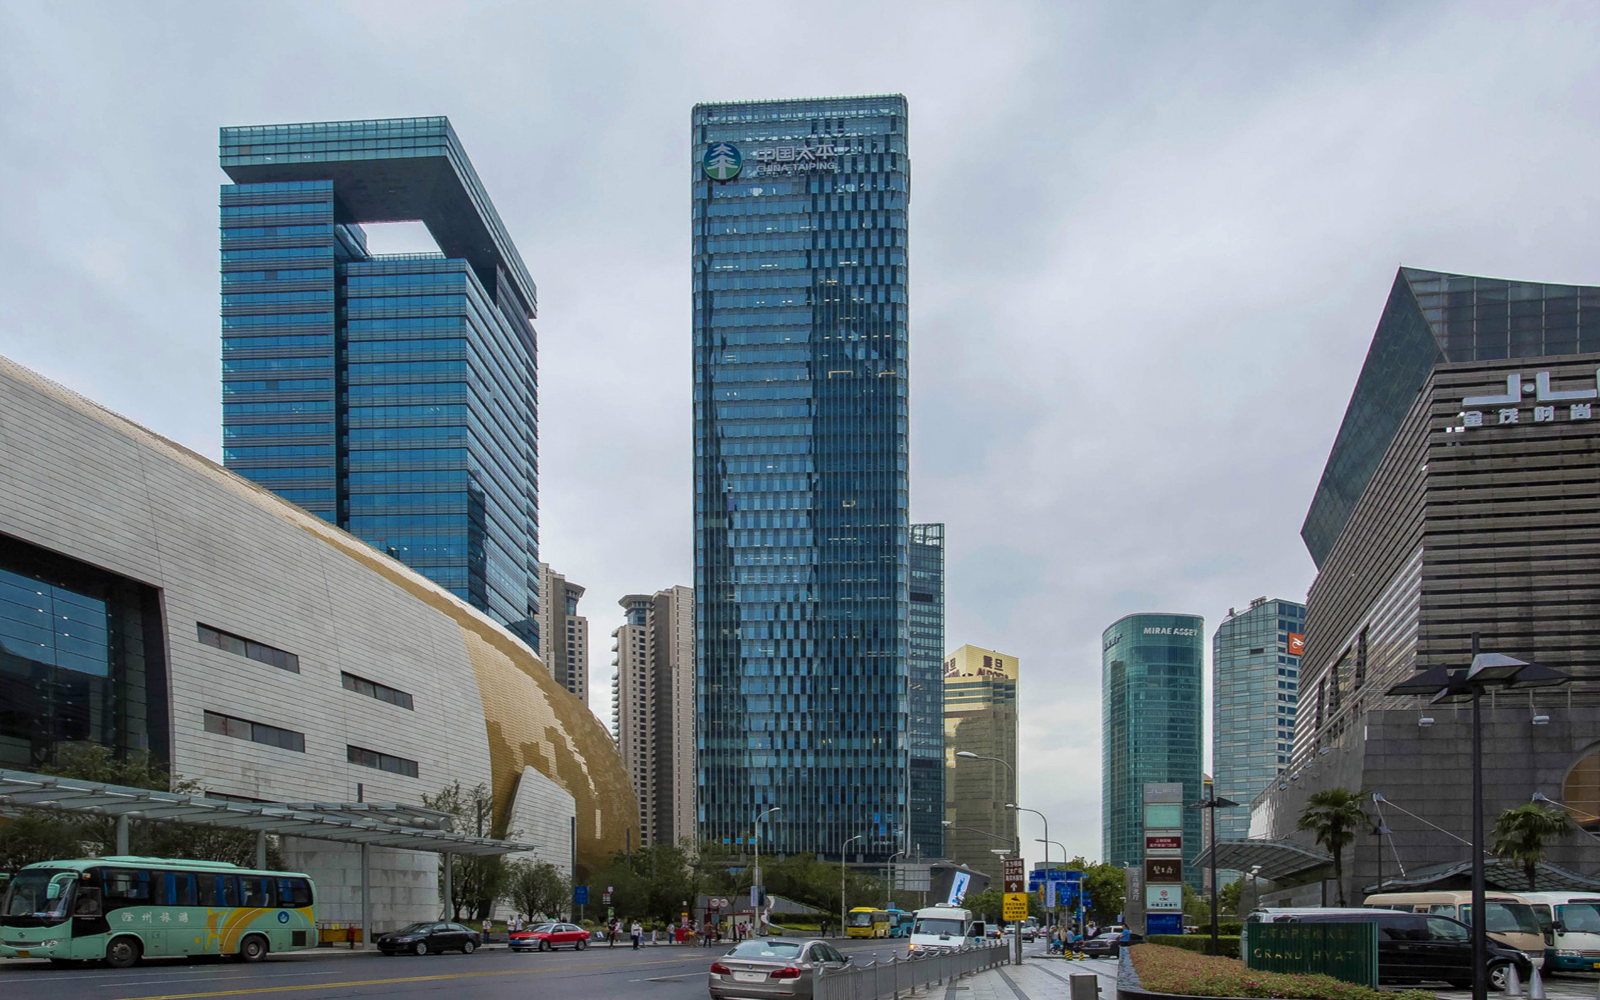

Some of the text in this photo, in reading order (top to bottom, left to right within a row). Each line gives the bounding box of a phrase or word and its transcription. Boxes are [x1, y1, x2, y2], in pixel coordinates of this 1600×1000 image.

[756, 144, 836, 163] 中国太平
[756, 162, 836, 173] CHINA TAIPING
[1464, 404, 1592, 427] 金茂时尚
[1143, 627, 1198, 637] MIRAE ASSET
[1253, 948, 1366, 962] GRAND HYATT
